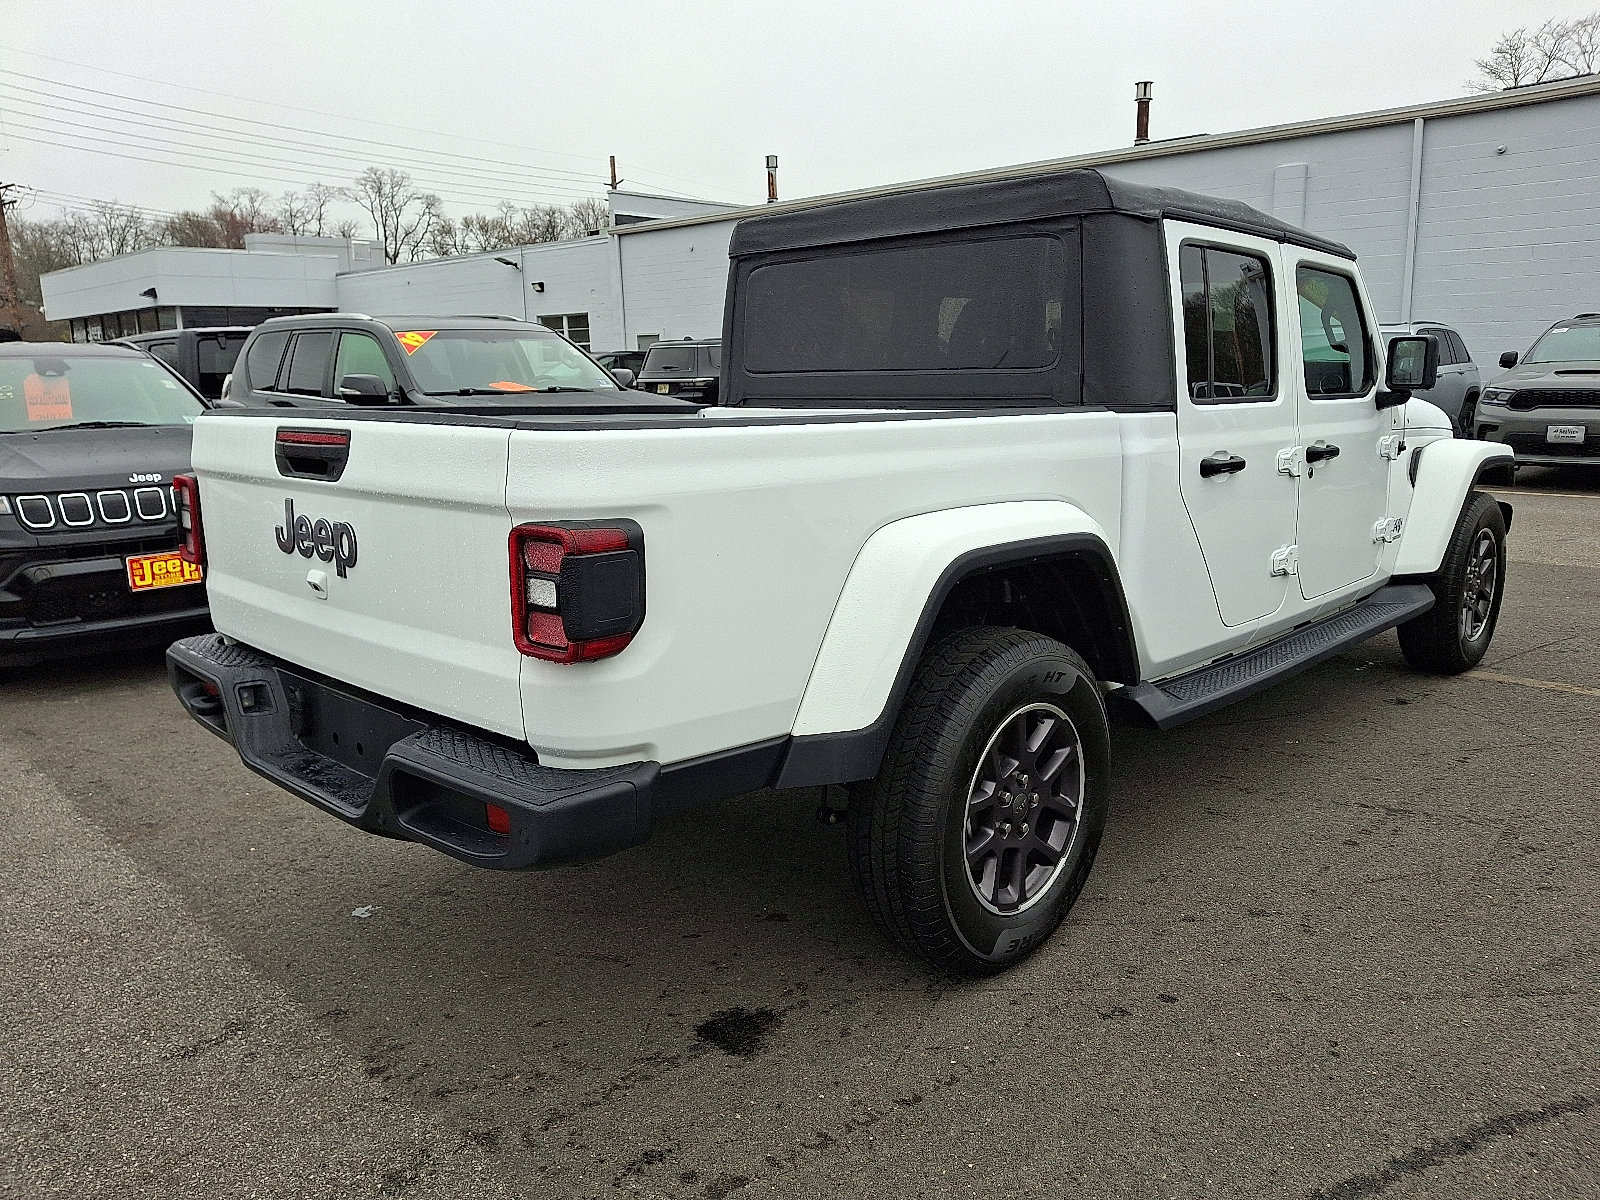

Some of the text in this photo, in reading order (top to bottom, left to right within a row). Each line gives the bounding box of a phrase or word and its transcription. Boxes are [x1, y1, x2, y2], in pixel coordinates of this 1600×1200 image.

[128, 472, 162, 483] Jeep
[274, 497, 358, 579] Jeep
[133, 558, 197, 587] Jeep
